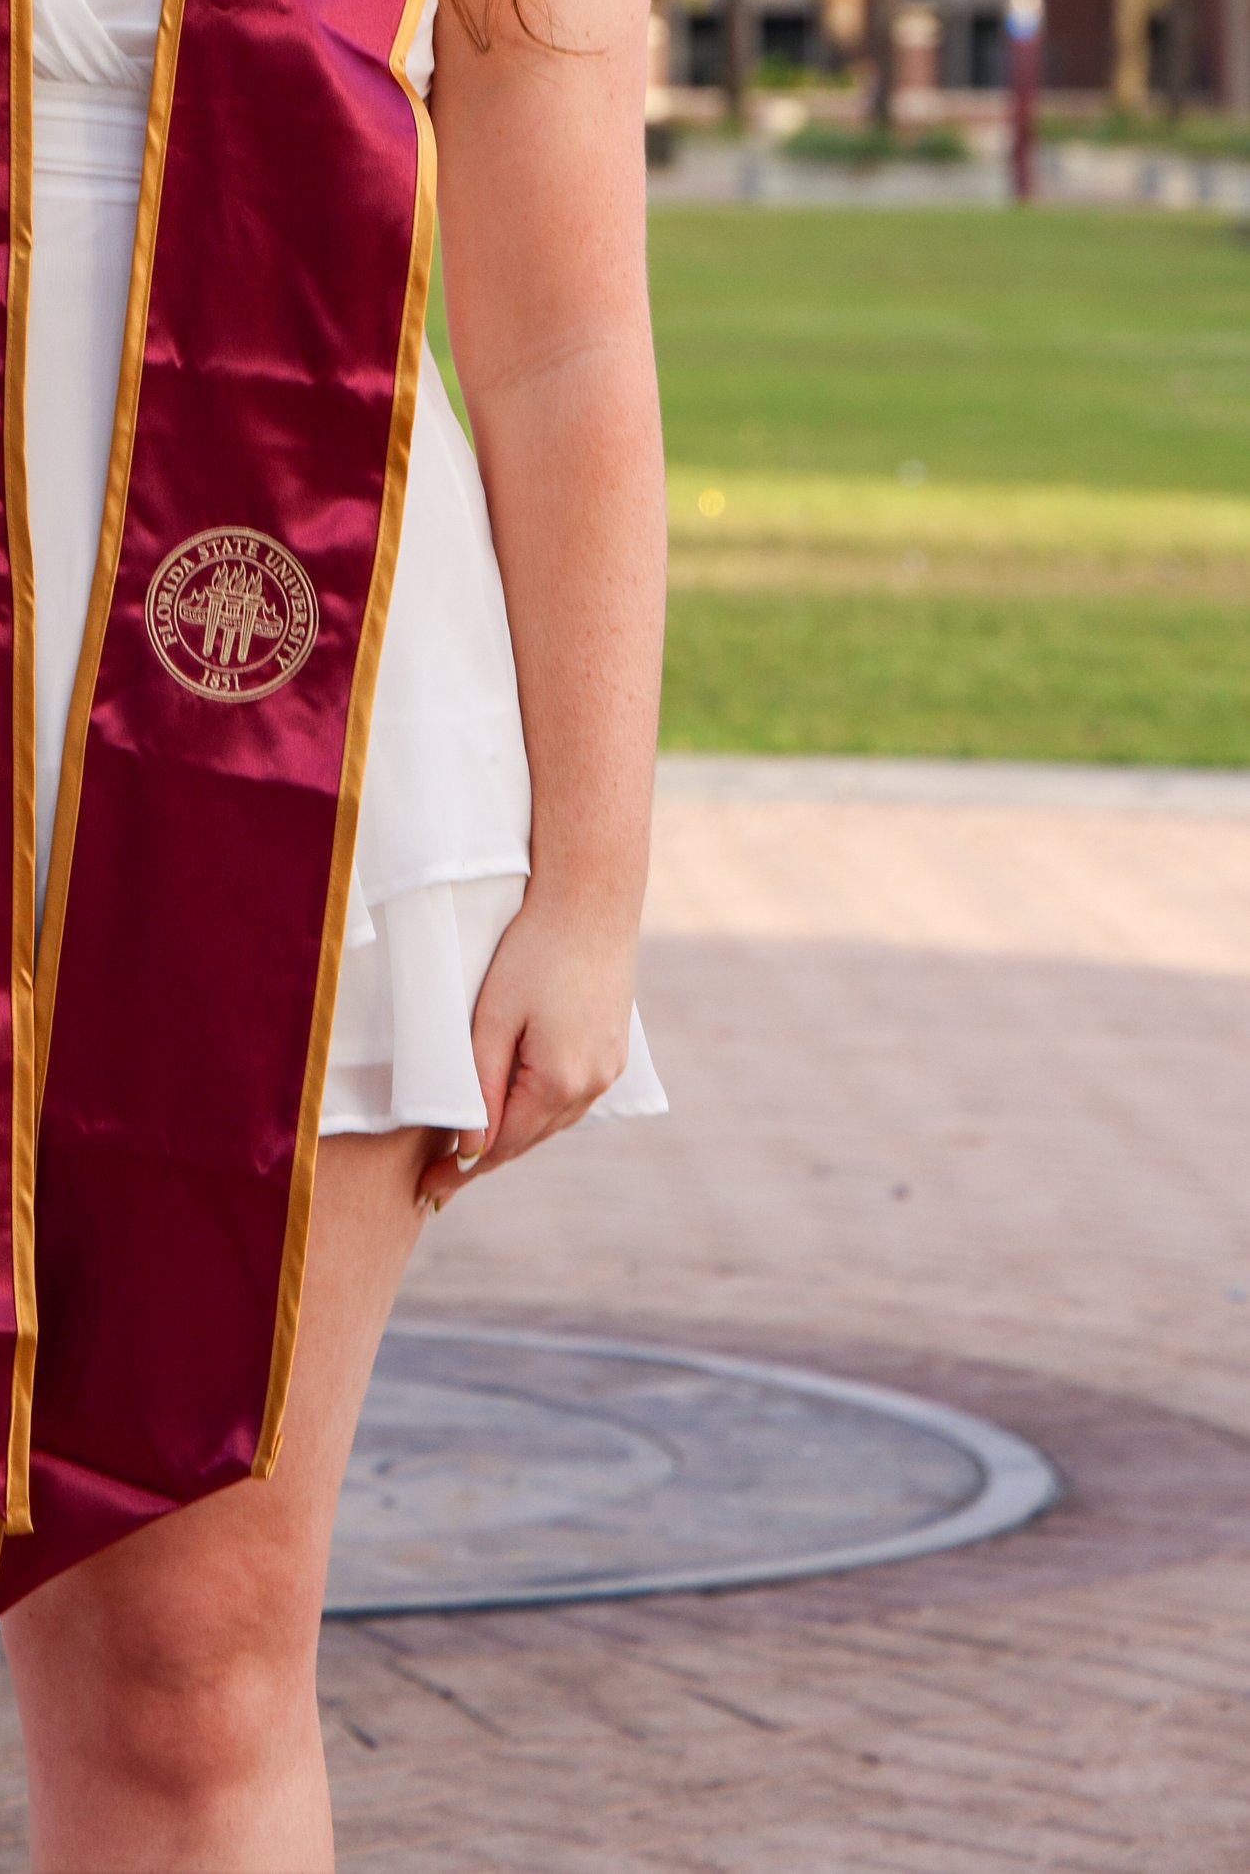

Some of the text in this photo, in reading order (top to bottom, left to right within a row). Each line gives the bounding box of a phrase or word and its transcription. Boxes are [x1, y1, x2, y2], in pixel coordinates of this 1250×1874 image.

[156, 536, 308, 671] FLORIDA STATE UNIVERSITY
[202, 668, 240, 692] 1851
